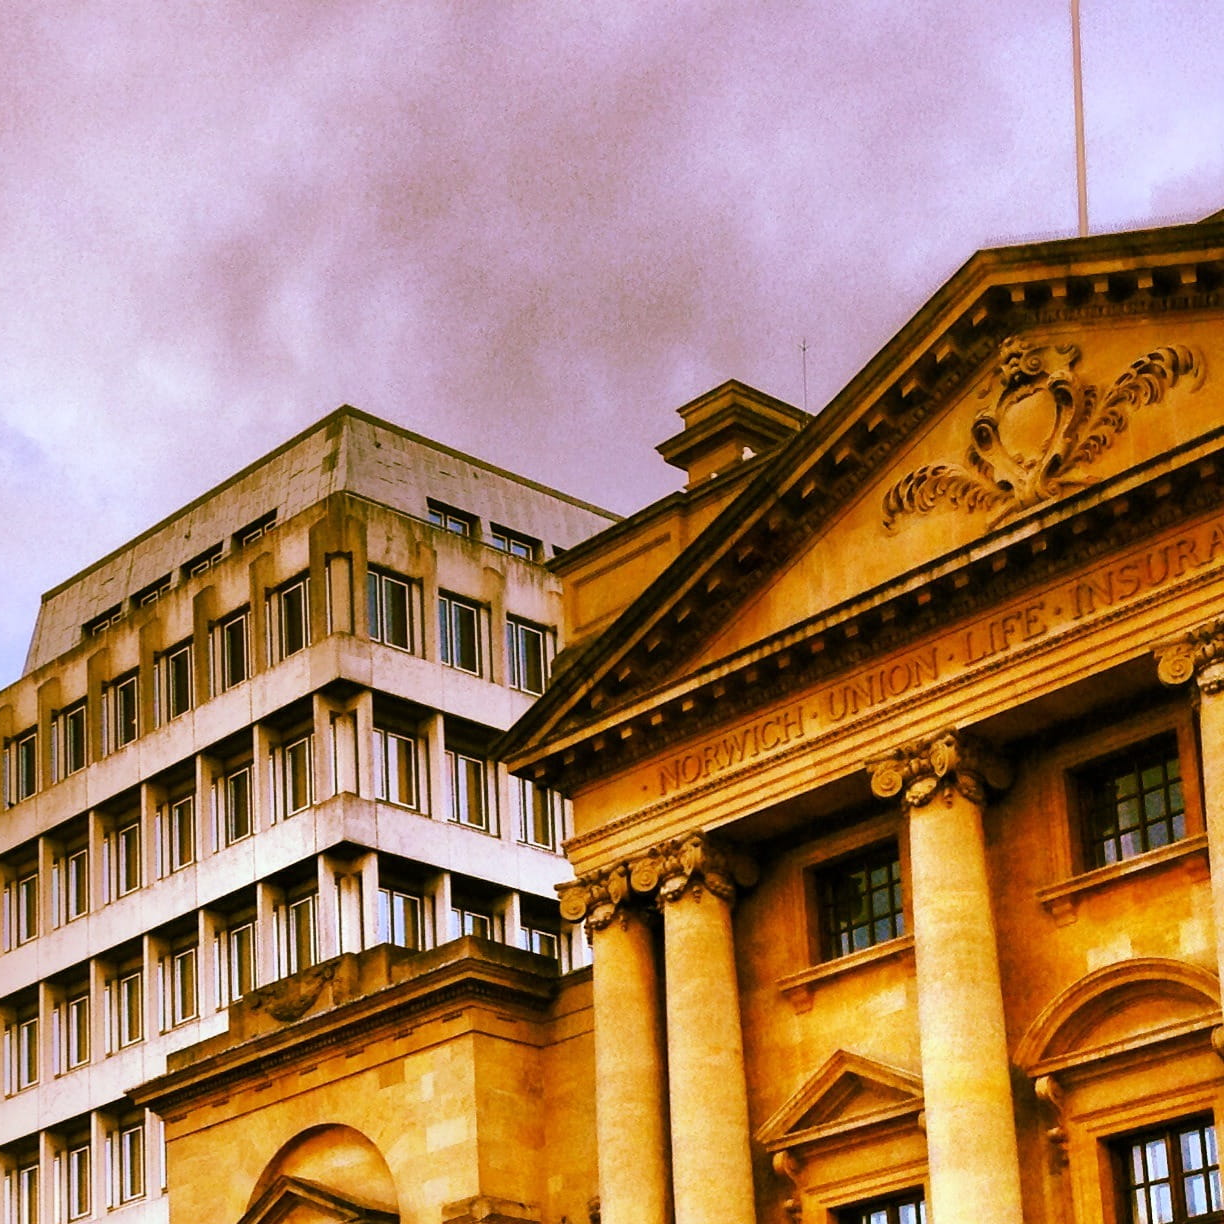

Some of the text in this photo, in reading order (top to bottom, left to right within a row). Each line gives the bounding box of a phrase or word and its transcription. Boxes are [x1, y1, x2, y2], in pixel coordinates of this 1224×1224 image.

[659, 704, 805, 796] NORWICH
[829, 646, 939, 722] UNION
[963, 601, 1048, 667] LIFE
